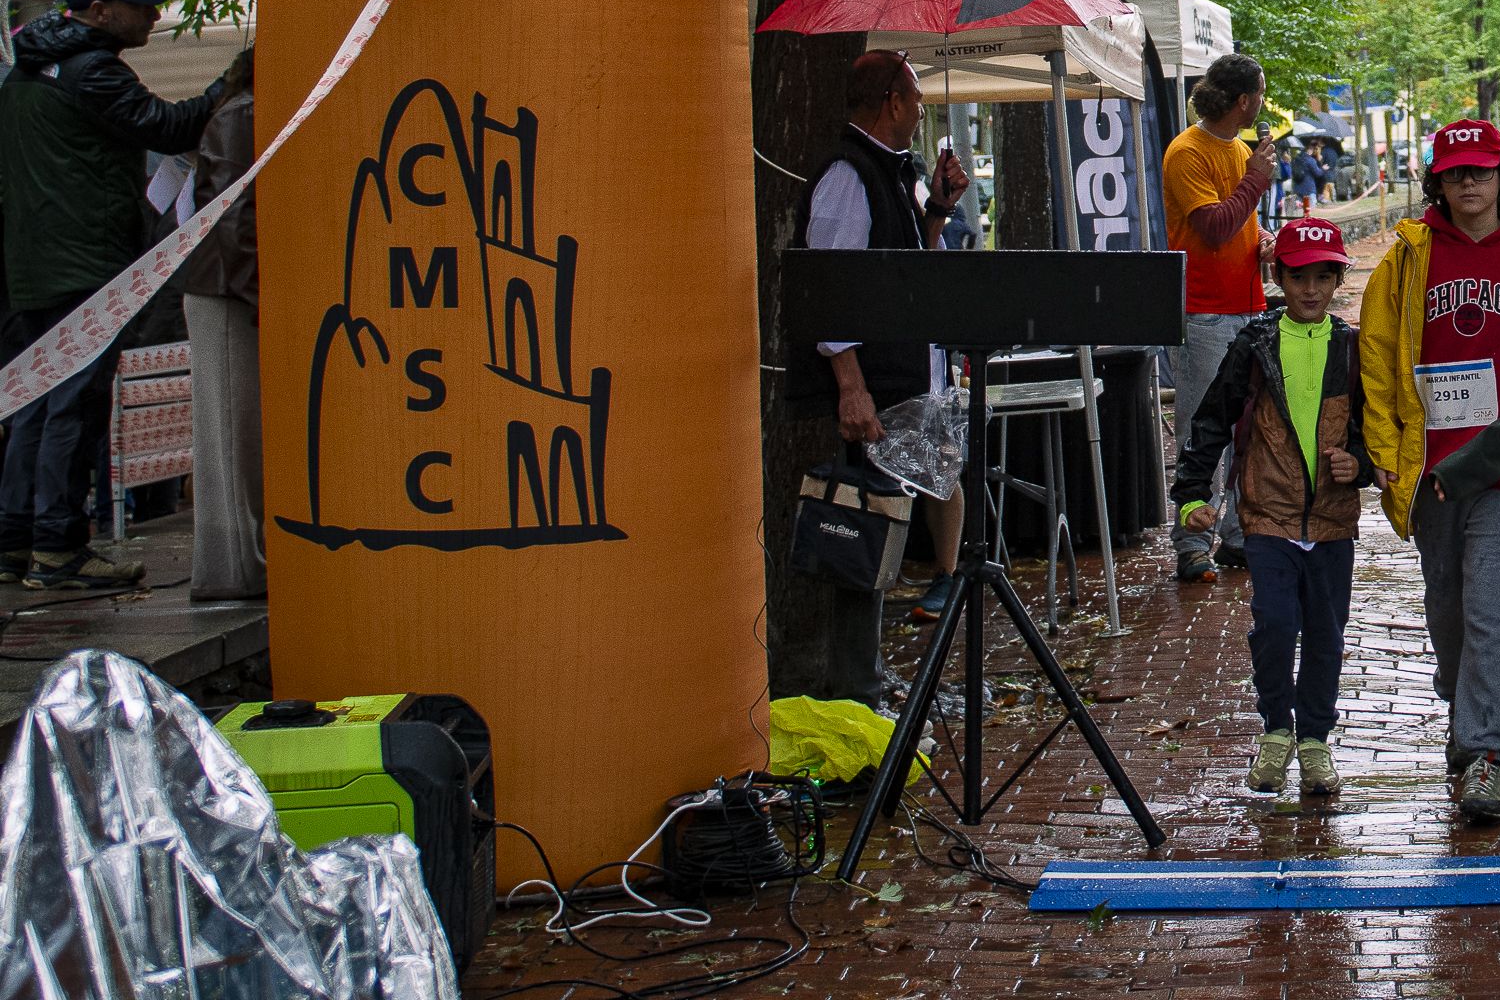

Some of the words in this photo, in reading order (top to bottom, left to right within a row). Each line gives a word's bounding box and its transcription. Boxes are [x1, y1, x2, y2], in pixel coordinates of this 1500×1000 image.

[1445, 129, 1482, 144] TOT
[1296, 226, 1333, 243] TOT
[1449, 373, 1481, 382] INFANTIL
[1434, 389, 1470, 402] 291B
